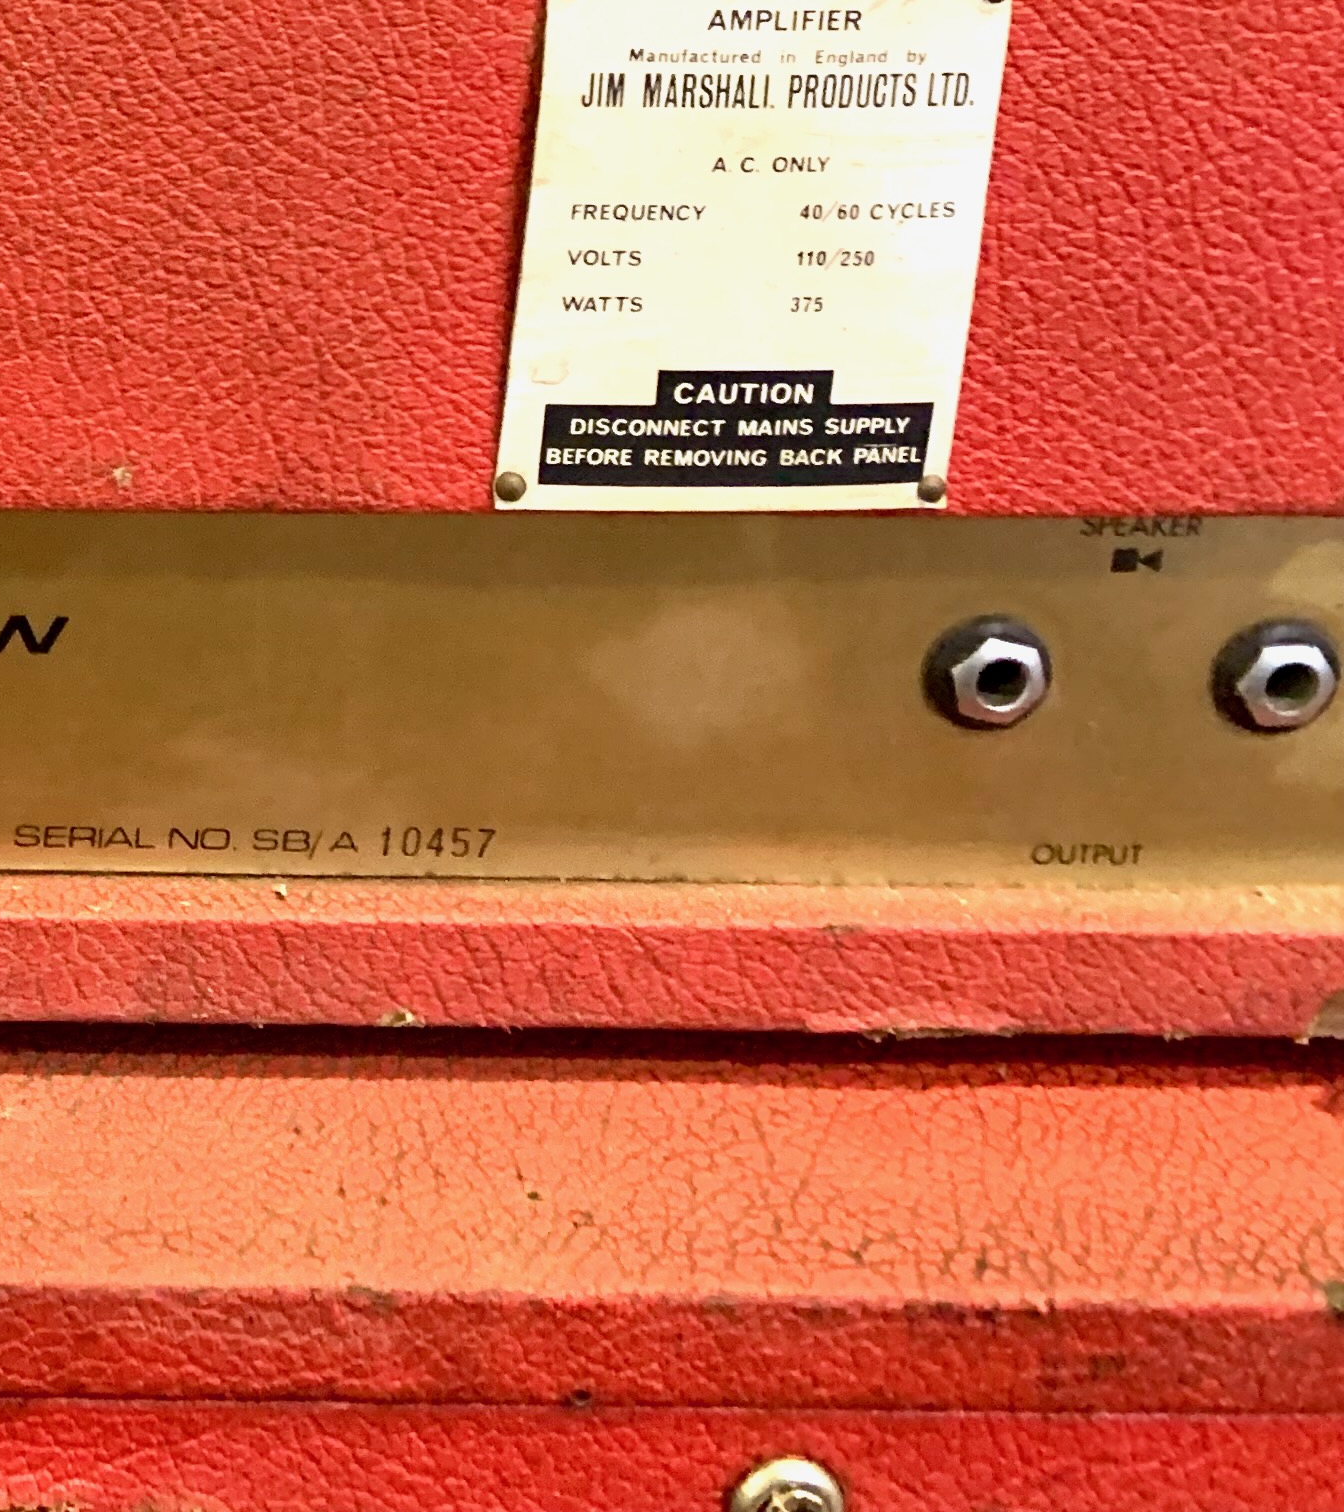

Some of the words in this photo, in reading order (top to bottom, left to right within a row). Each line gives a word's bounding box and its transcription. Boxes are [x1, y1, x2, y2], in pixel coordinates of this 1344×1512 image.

[707, 9, 863, 32] AMPLIFIER
[628, 48, 762, 65] Manufactured
[780, 50, 797, 65] in
[814, 50, 889, 68] England
[906, 49, 928, 66] by
[580, 72, 626, 109] JIM
[787, 72, 919, 109] PRODUCTS
[926, 71, 976, 108] LTD.
[771, 156, 832, 174] ONLY
[570, 203, 707, 223] FREQUENCY
[799, 201, 861, 223] 40/60
[869, 201, 957, 220] CYCLES
[567, 249, 643, 267] VOLTS
[796, 248, 876, 270] 110/250
[561, 295, 644, 313] WATTS
[790, 296, 825, 313] 375
[673, 381, 815, 405] CAUTION
[569, 417, 727, 437] DISCONNECT
[736, 417, 814, 437] MAINS
[823, 416, 912, 436] SUPPLY
[544, 447, 633, 467] BEFORE
[643, 448, 768, 467] REMOVING
[778, 448, 844, 467] BACK
[852, 445, 922, 465] PANEL
[13, 824, 156, 851] SERIAL
[167, 826, 238, 852] NO.
[379, 826, 498, 860] 10457
[1030, 842, 1145, 867] OUTPUT
